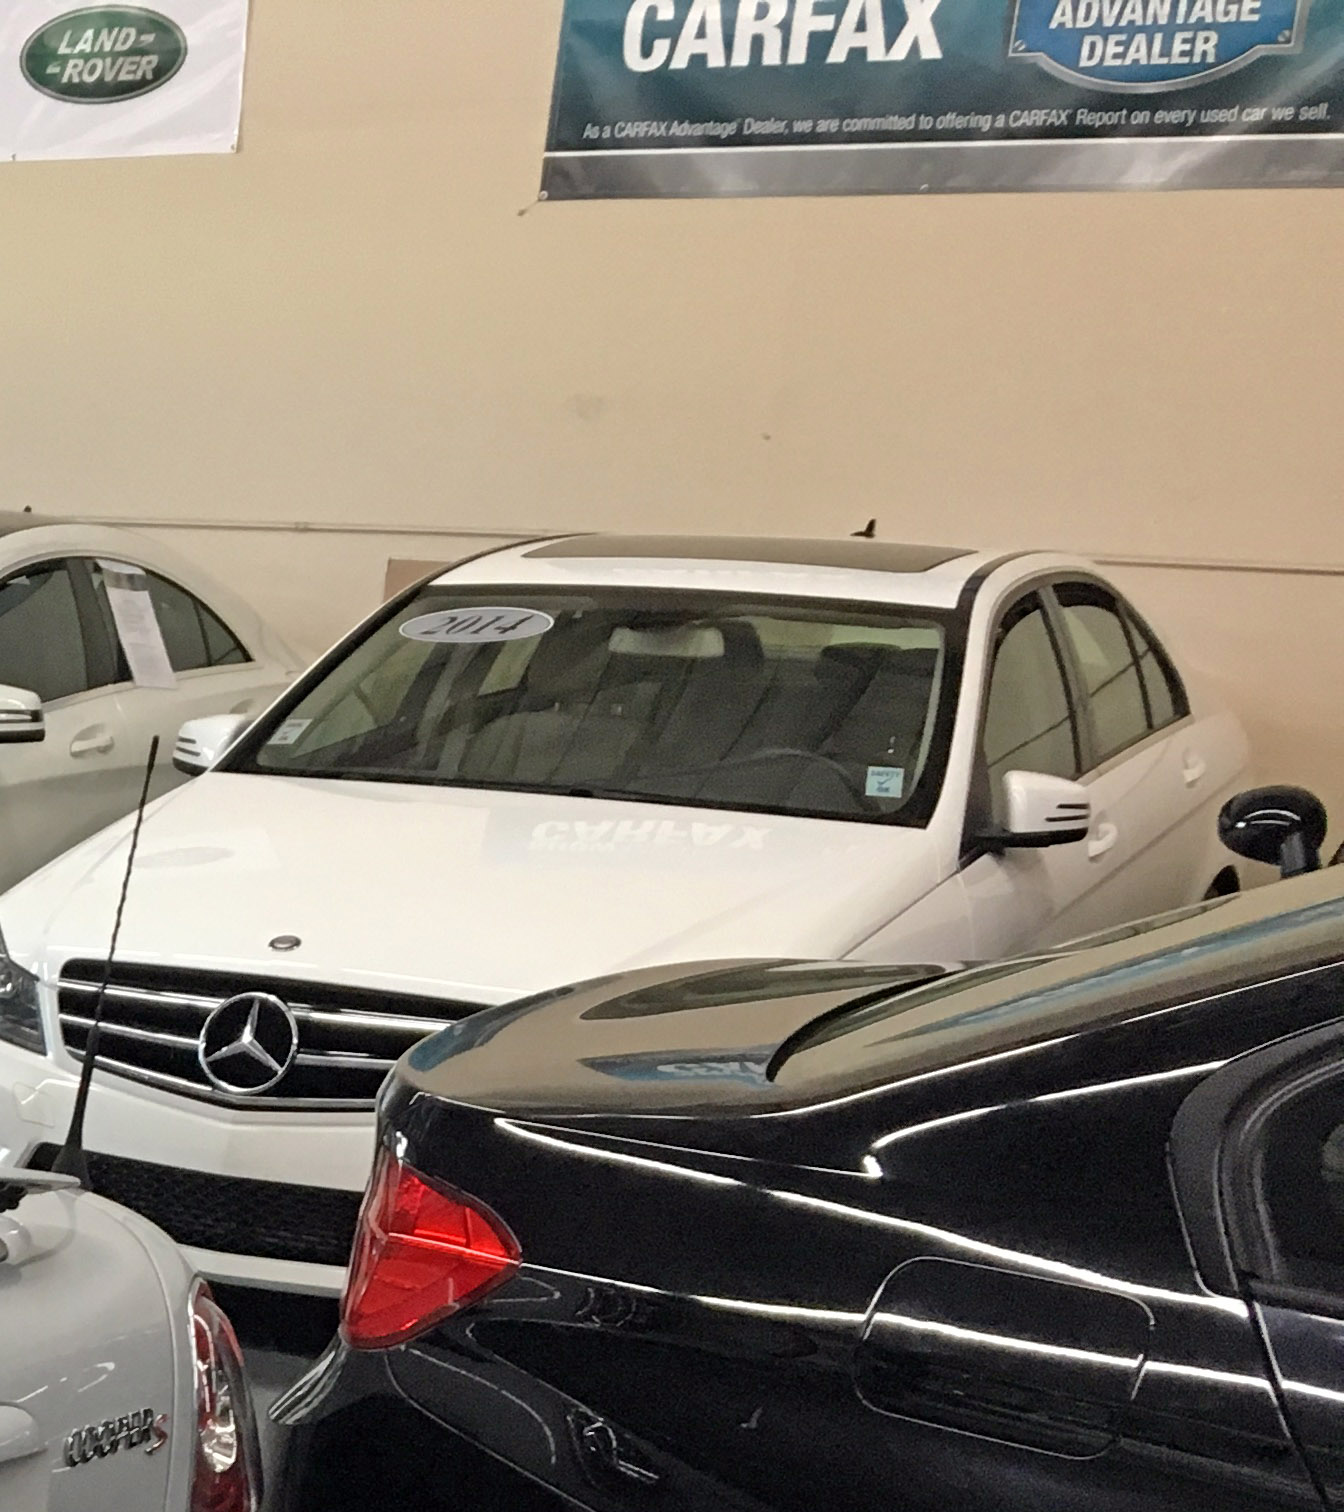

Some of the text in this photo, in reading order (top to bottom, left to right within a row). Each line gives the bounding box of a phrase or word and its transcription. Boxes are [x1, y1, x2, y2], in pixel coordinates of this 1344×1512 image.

[1049, 0, 1262, 29] ADVANTAGE
[58, 27, 135, 54] LAND
[623, 0, 943, 72] CARFAX
[1079, 31, 1219, 68] DEALER
[62, 54, 159, 83] ROVER
[583, 102, 1331, 139] As a CARFAX Advantage Dealer, we are committed to offering a CARFAX Report on every used car we sell.
[419, 613, 536, 635] 2014
[145, 1413, 169, 1455] S
